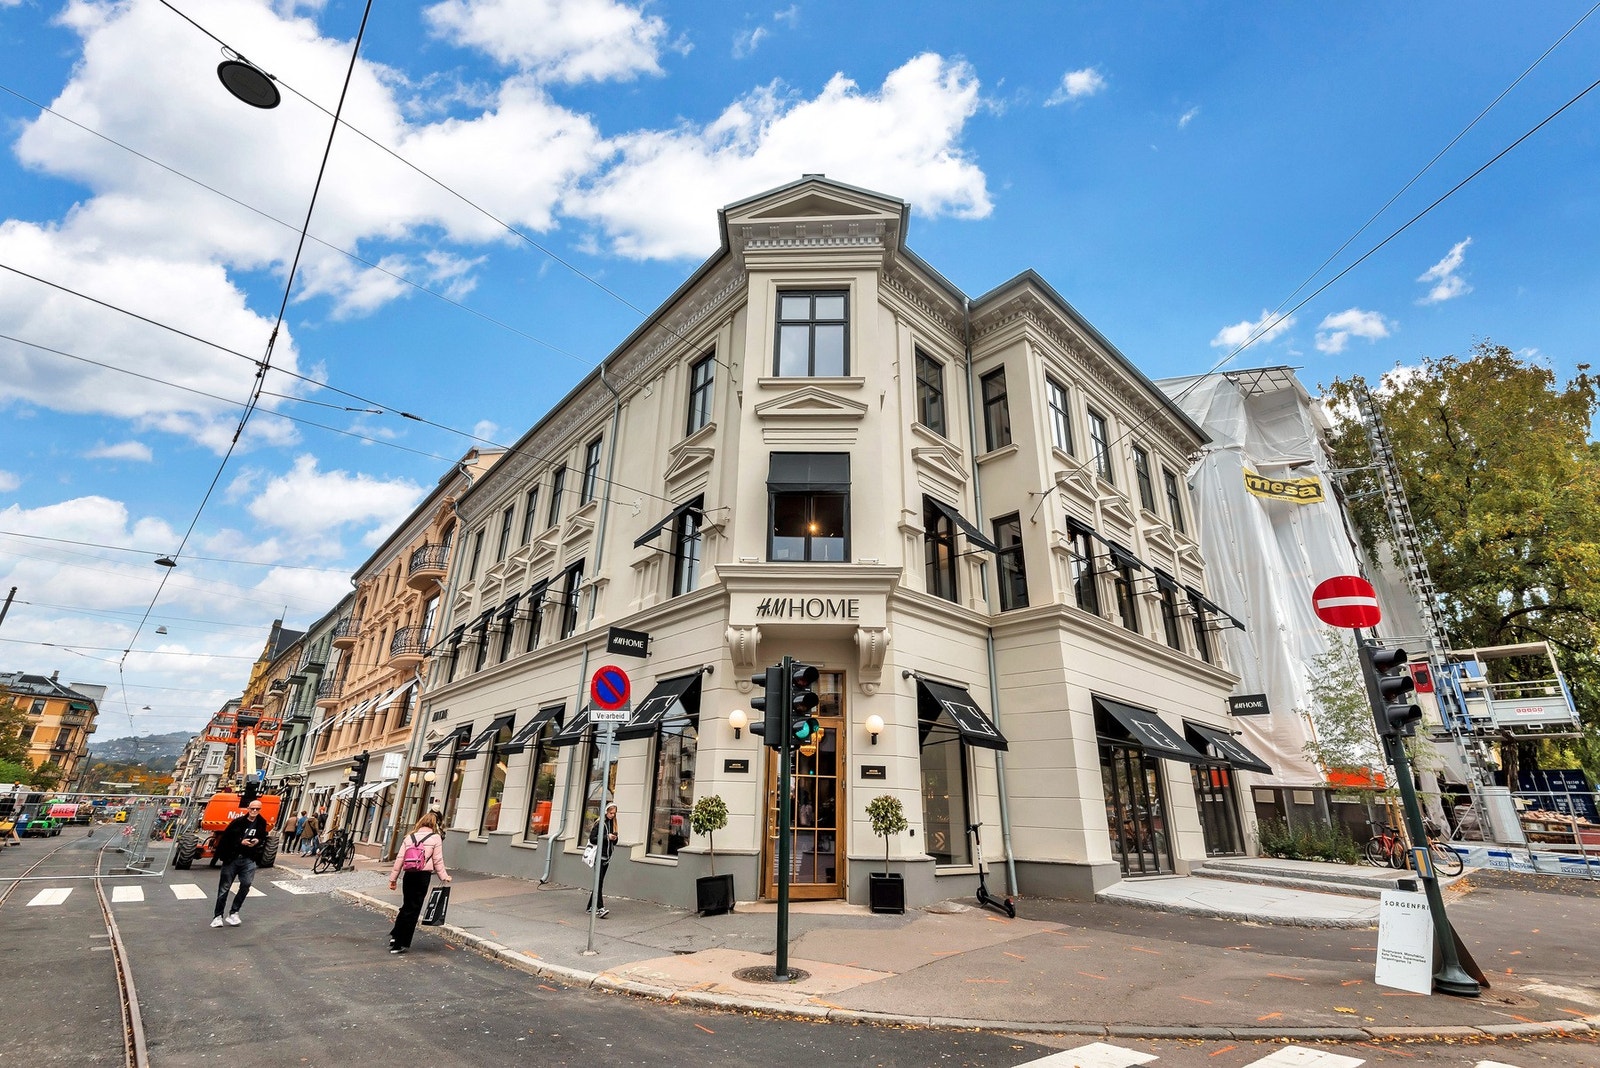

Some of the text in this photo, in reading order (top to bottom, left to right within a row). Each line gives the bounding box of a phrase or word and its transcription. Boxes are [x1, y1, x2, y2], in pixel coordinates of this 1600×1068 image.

[1247, 476, 1318, 497] mesa
[789, 598, 859, 619] HOME
[622, 638, 644, 649] HOME
[1385, 900, 1429, 911] SORGENFRI
